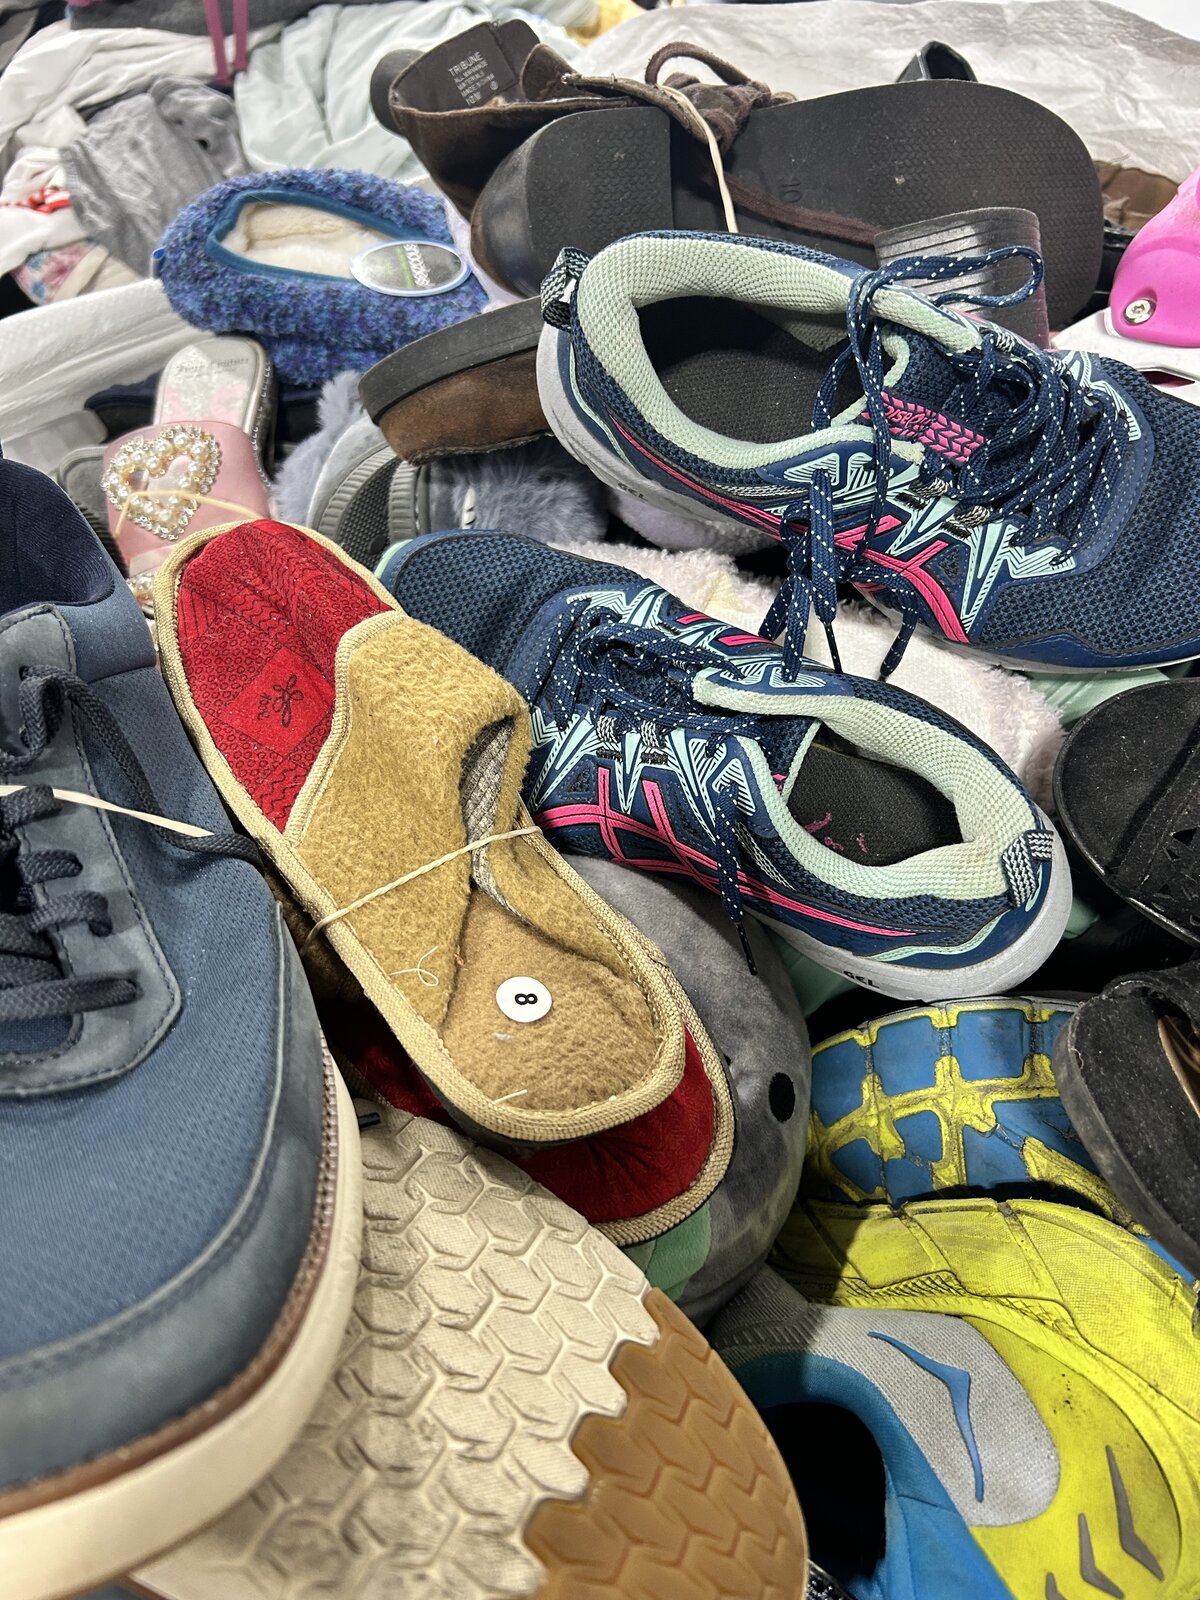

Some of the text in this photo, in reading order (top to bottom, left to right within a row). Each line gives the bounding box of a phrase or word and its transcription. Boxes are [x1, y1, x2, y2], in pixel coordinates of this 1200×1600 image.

[448, 52, 483, 76] TRIBUNE
[843, 970, 880, 989] GEL
[514, 993, 538, 1006] 8
